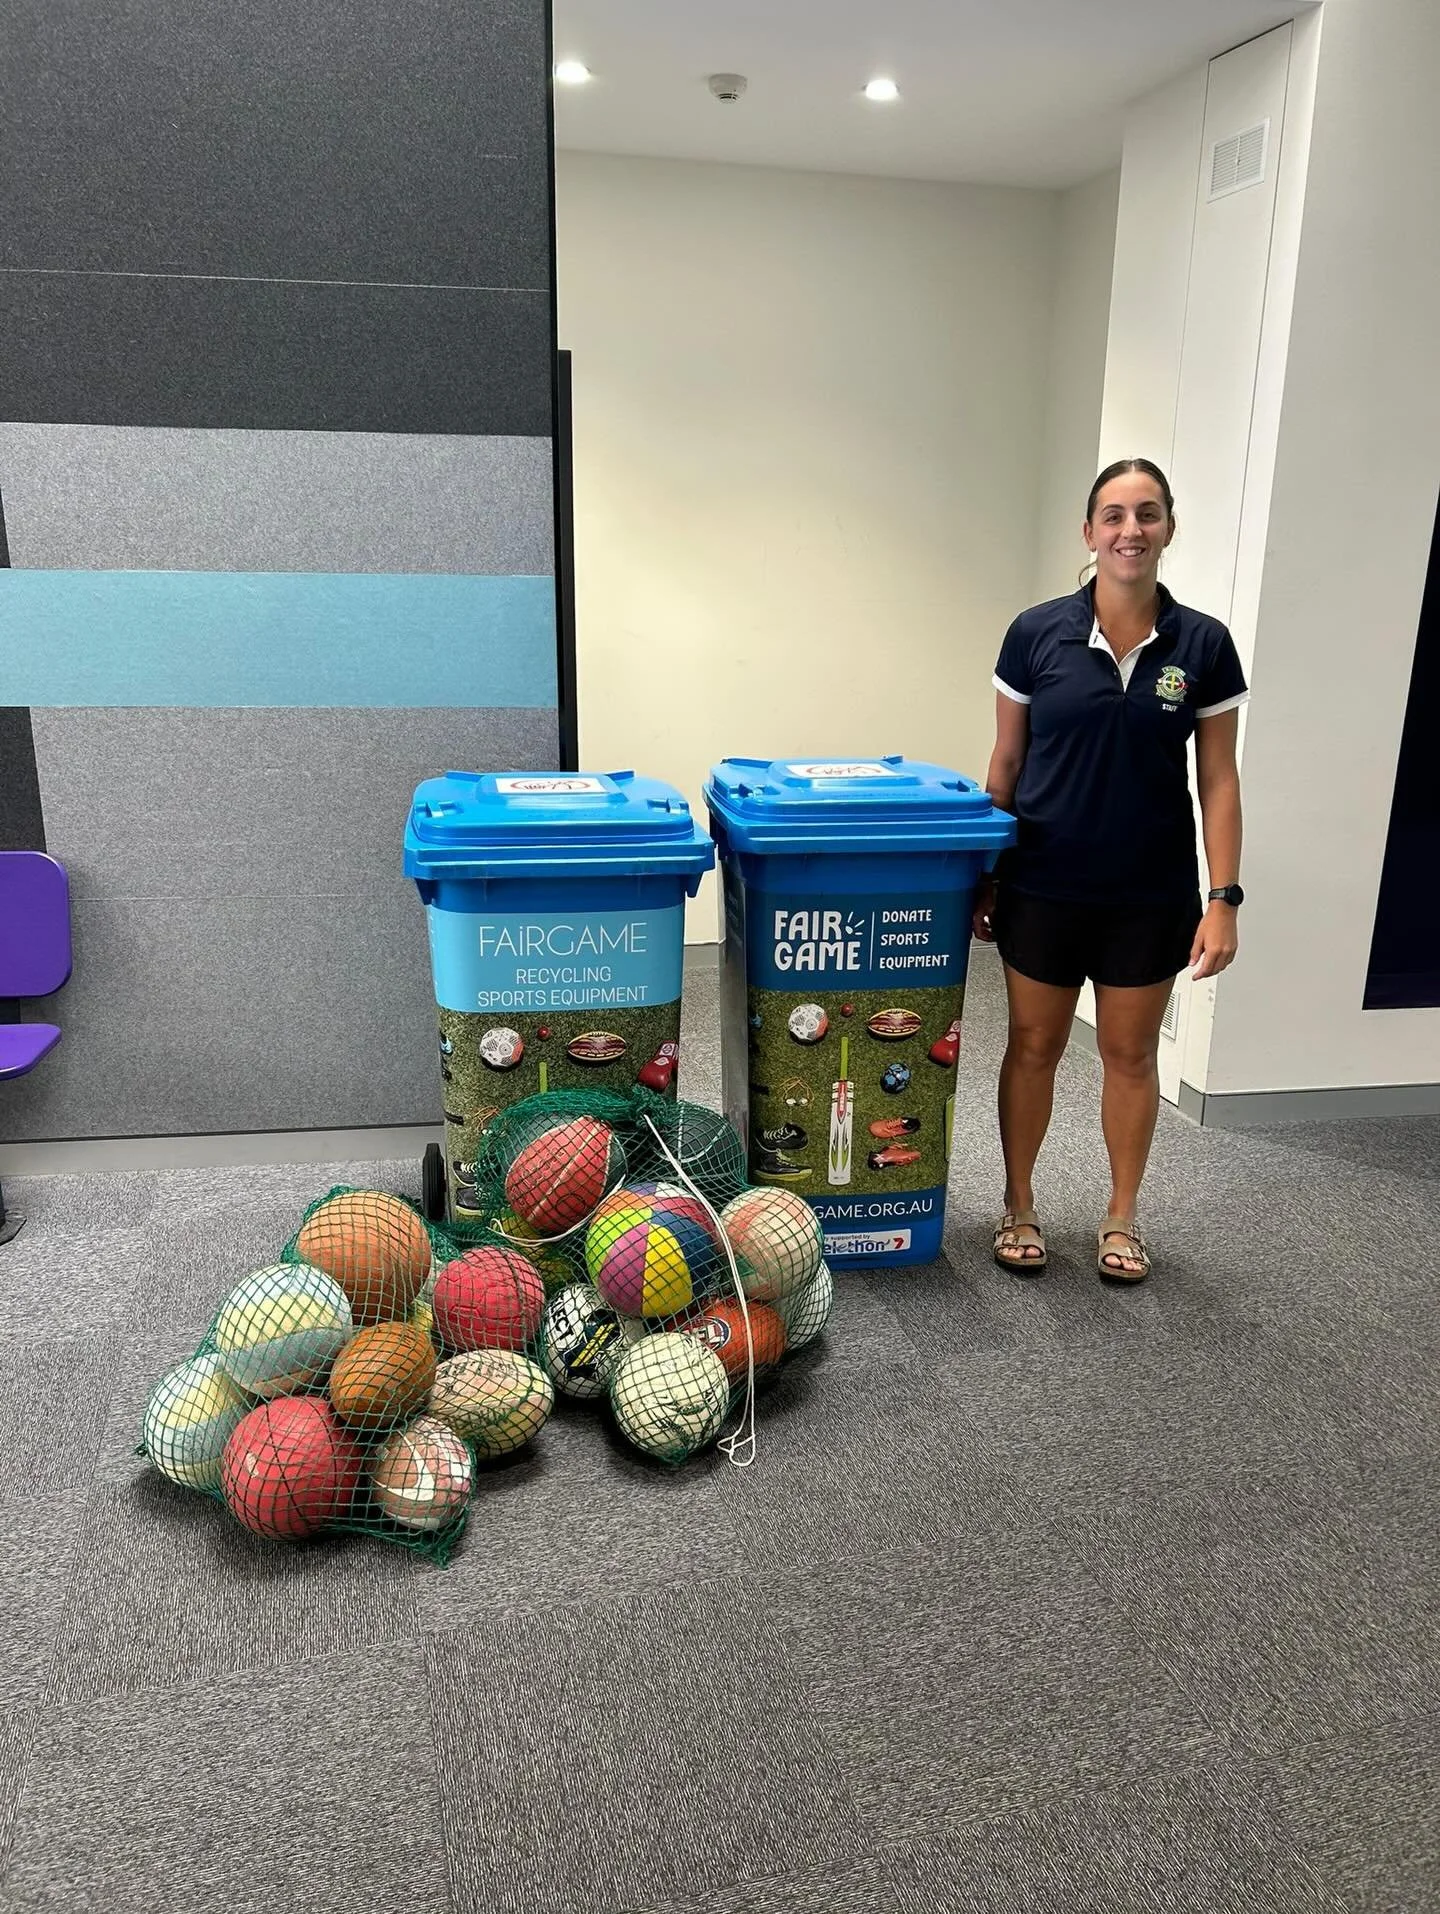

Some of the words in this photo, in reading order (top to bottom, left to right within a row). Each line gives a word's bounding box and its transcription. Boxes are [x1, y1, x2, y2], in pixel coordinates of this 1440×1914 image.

[774, 910, 842, 940] FAIR
[882, 909, 932, 924] DONATE
[880, 932, 929, 946] SPORTS
[774, 941, 861, 971] GAME
[879, 954, 950, 971] EQUIPMENT
[516, 966, 612, 985] RECYCLING
[477, 989, 546, 1007] SPORTS
[551, 985, 649, 1007] EQUIPMENT
[814, 1198, 933, 1220] GAME.ORG.AU
[823, 1239, 887, 1255] elethon
